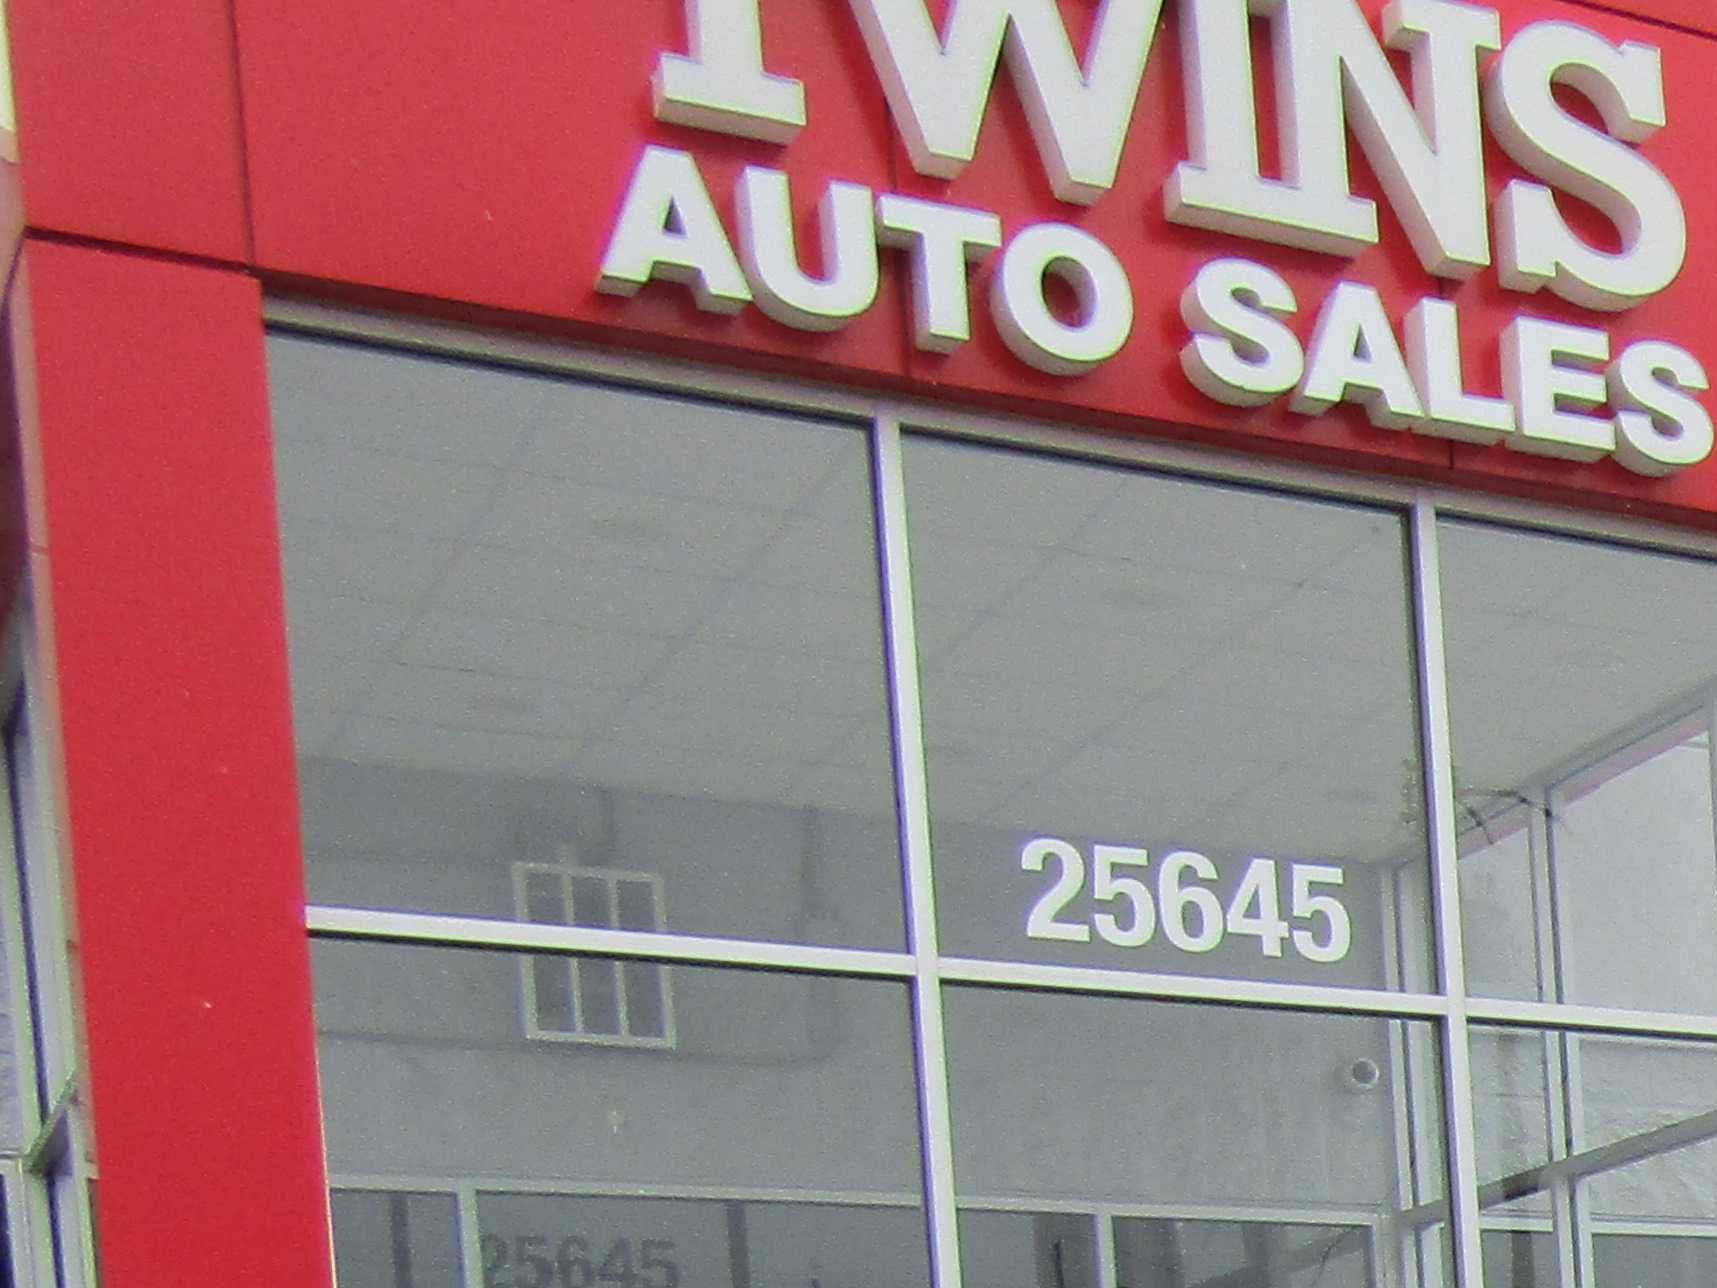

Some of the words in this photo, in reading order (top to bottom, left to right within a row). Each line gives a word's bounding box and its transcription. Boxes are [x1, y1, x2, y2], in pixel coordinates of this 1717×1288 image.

[596, 145, 1132, 375] AUTO
[1180, 258, 1714, 477] SALES
[1021, 837, 1351, 964] 25645
